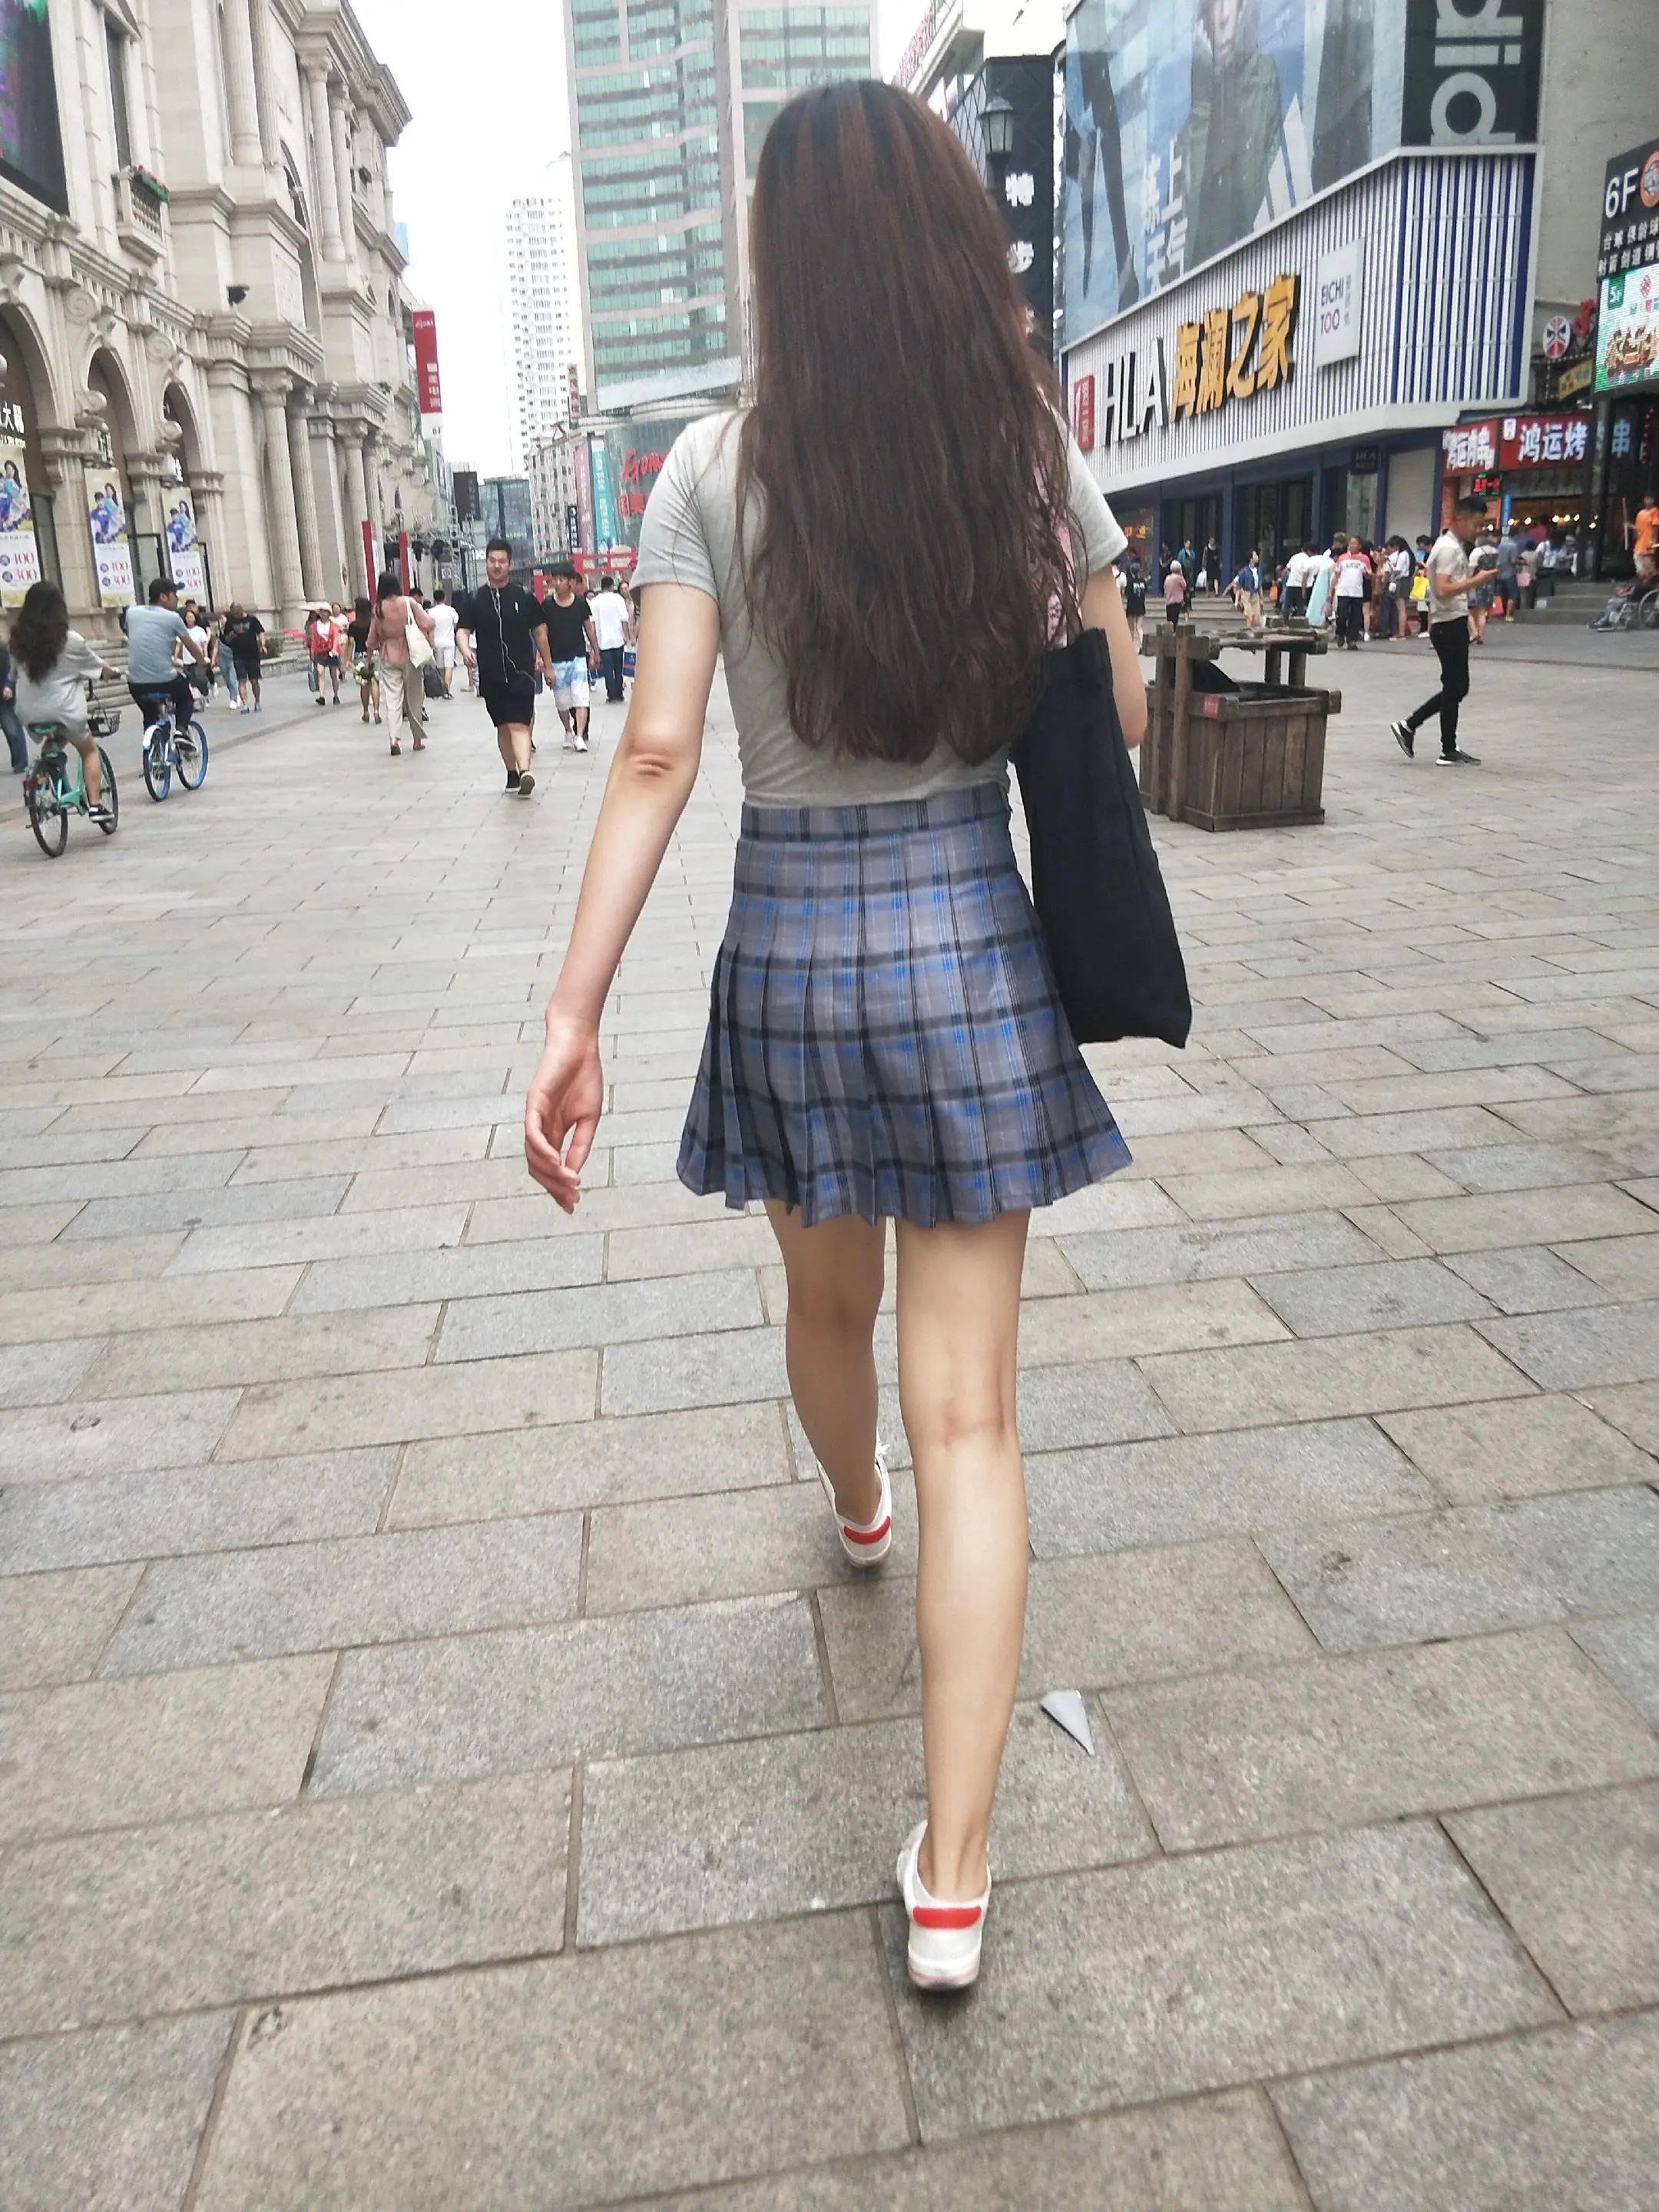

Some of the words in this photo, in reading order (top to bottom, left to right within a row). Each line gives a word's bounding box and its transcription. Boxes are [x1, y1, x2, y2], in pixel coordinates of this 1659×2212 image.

[1605, 167, 1639, 219] 6F
[1321, 277, 1344, 306] EICHI
[1320, 308, 1340, 336] TOO
[1171, 273, 1296, 423] 海澜之家
[1101, 336, 1166, 447] HLA
[1518, 420, 1588, 462] 鸿运烤
[618, 490, 651, 518] 国美
